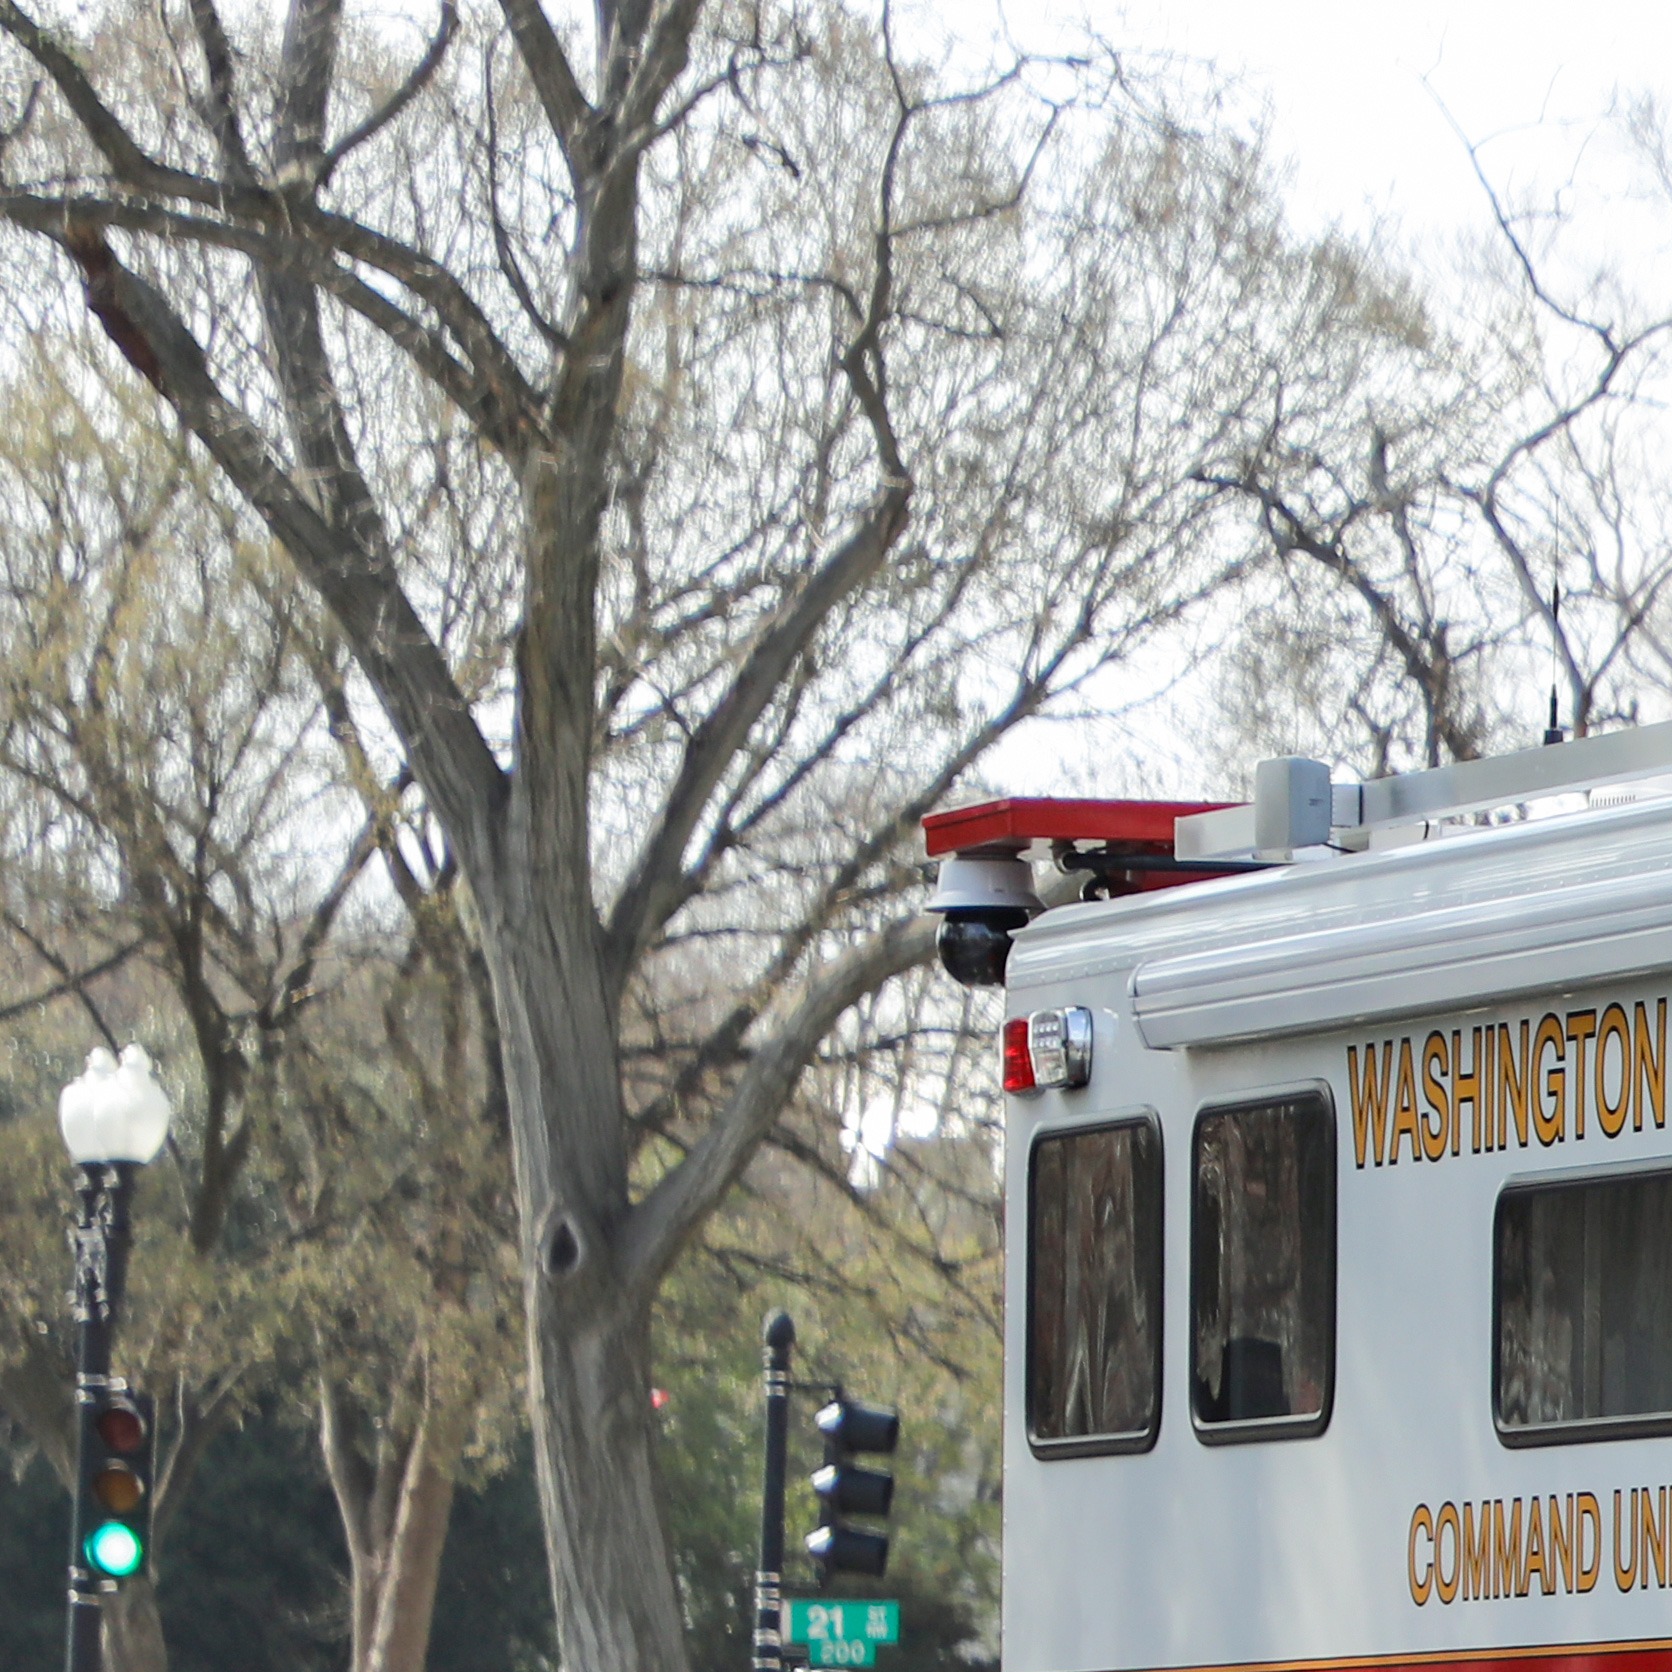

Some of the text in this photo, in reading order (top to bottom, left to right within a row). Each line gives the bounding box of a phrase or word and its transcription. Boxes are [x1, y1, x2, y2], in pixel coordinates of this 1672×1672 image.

[1346, 998, 1668, 1169] WASHINGTON
[1408, 1490, 1601, 1606] COMMAND
[807, 1604, 844, 1640] 21
